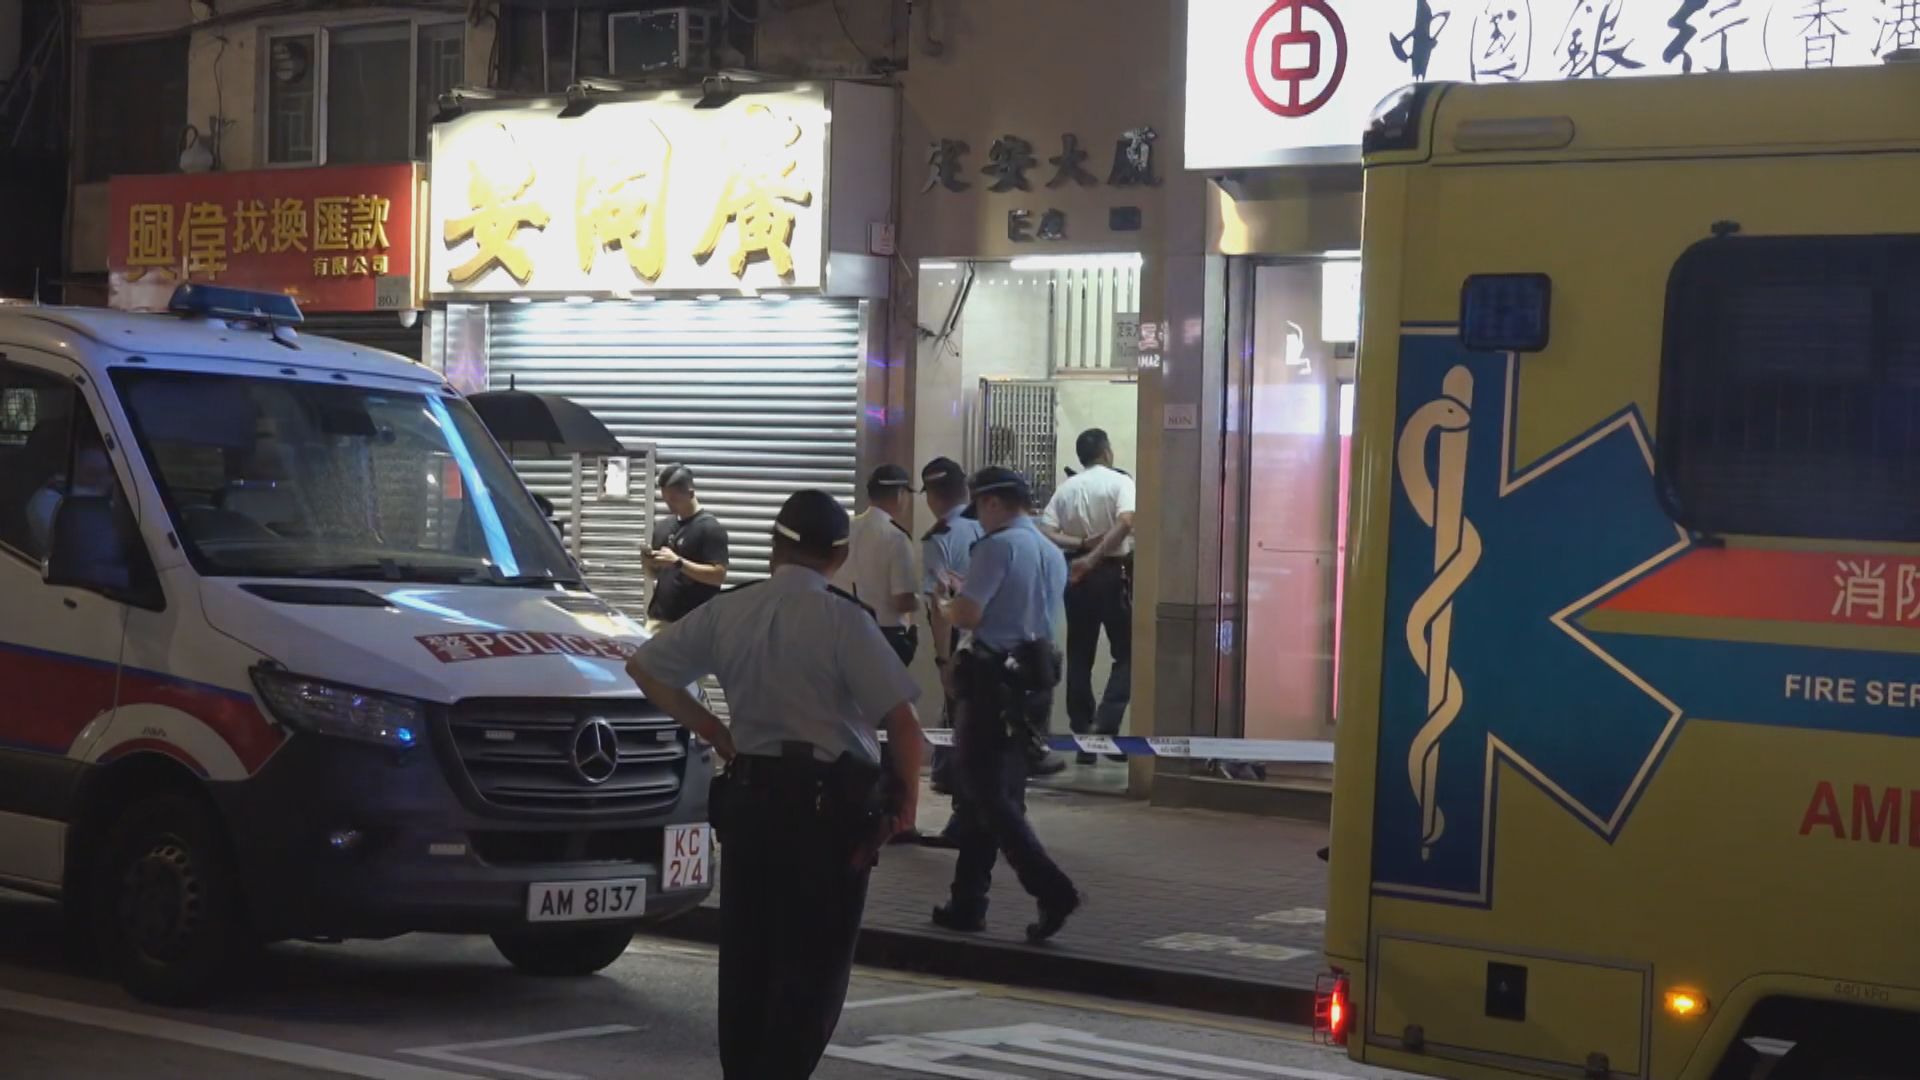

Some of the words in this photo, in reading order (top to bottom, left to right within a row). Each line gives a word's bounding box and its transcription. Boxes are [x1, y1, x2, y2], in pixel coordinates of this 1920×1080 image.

[313, 255, 389, 276] 有限公司
[463, 631, 623, 661] POLICE
[1784, 674, 1856, 704] FIRE
[1799, 780, 1920, 848] AM
[674, 828, 701, 857] KC
[669, 859, 703, 888] 2/4
[540, 889, 574, 916] AM
[584, 886, 638, 914] 8137
